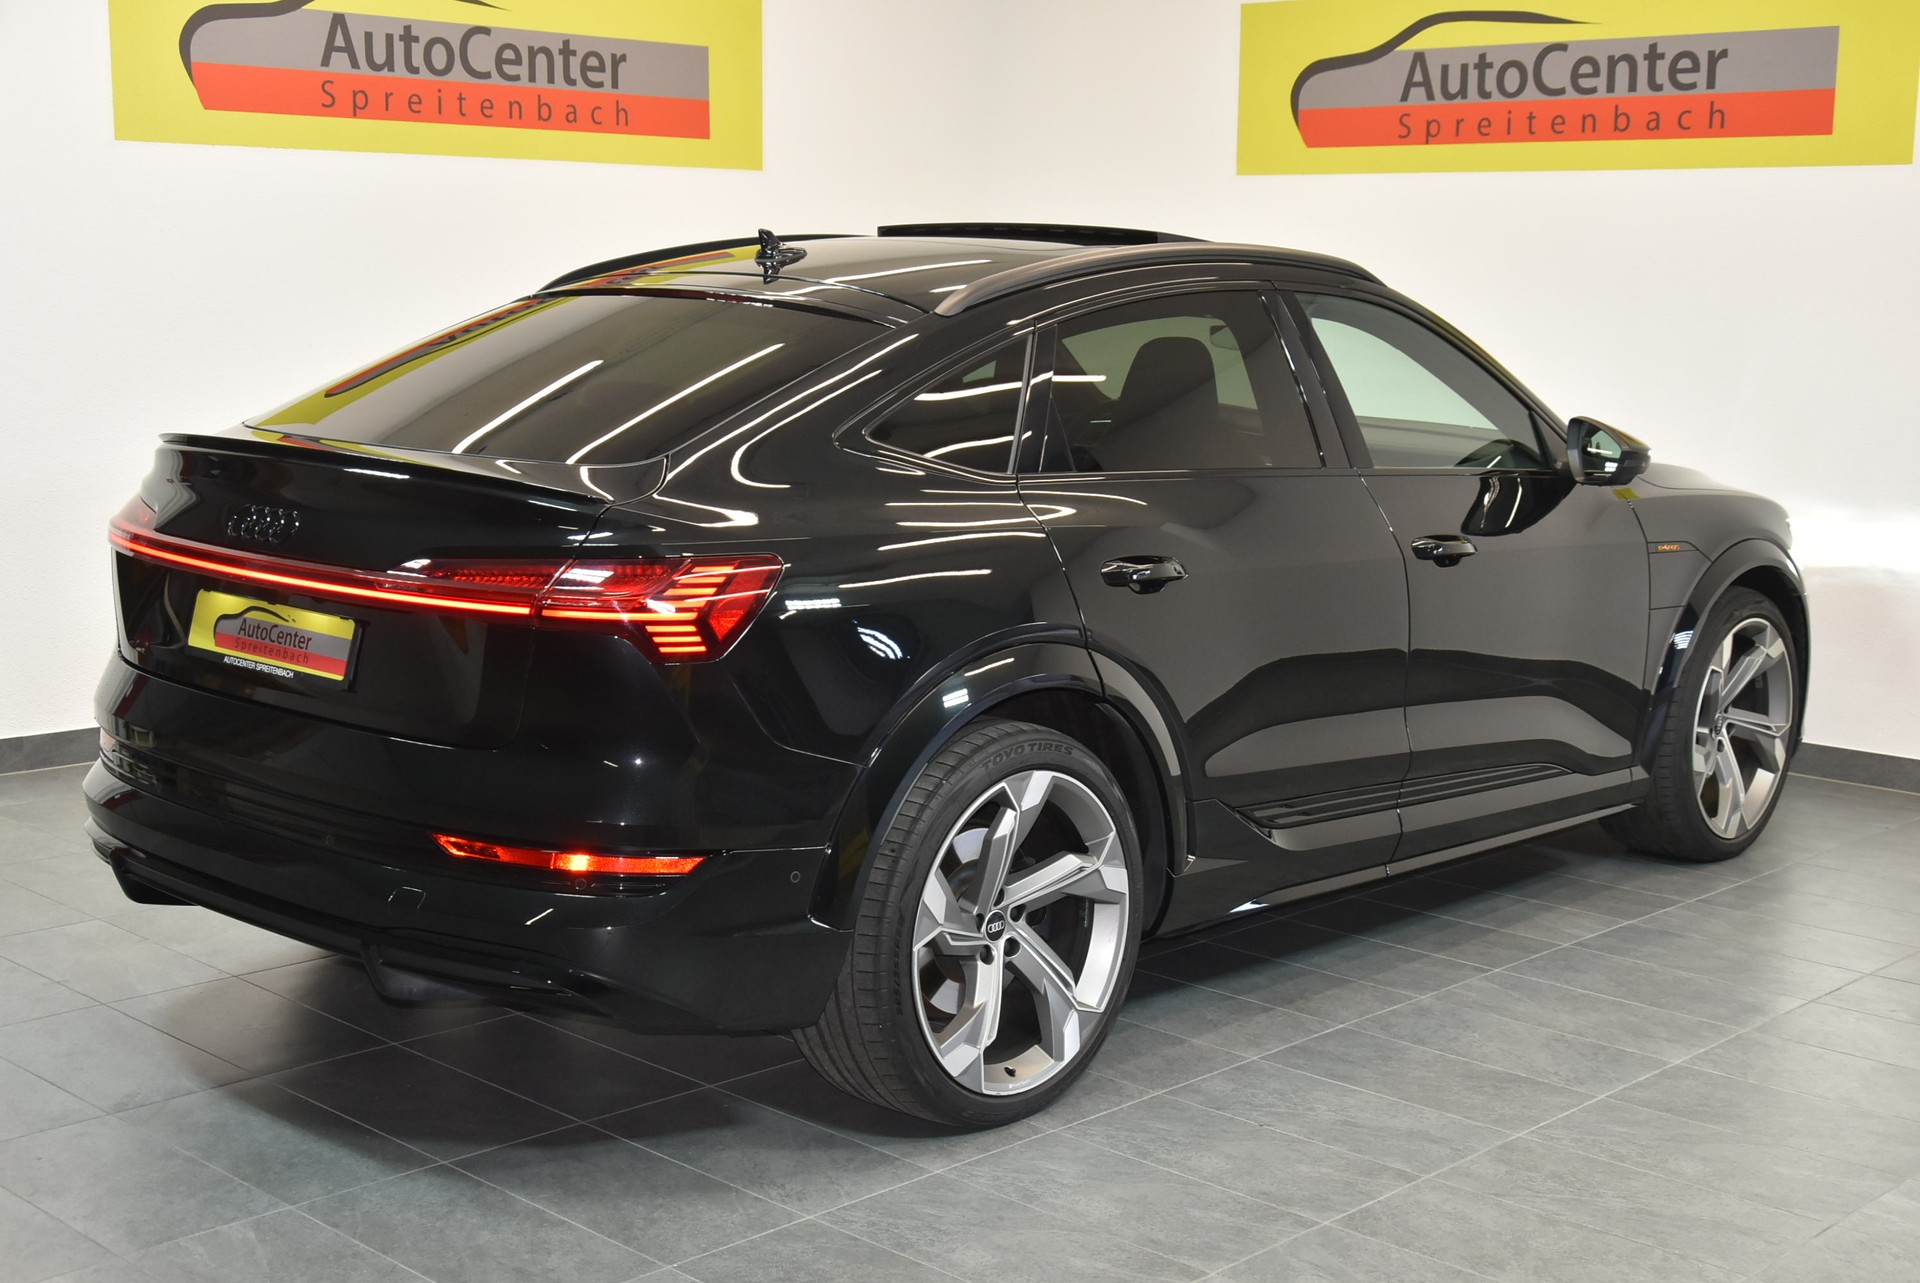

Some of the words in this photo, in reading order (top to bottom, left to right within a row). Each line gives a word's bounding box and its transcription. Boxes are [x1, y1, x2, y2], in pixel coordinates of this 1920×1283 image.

[320, 12, 627, 89] AutoCenter
[1400, 42, 1729, 102] AutoCenter
[320, 80, 629, 126] Spreitenbach
[1398, 101, 1726, 144] Spreitenbach
[235, 637, 309, 664] Spreitenbach
[238, 618, 312, 650] AutoCenter
[223, 655, 256, 669] AUTOCENTER
[255, 663, 294, 678] SPREITENBACH
[980, 747, 1025, 771] TOYO
[1027, 741, 1073, 756] TIRES
